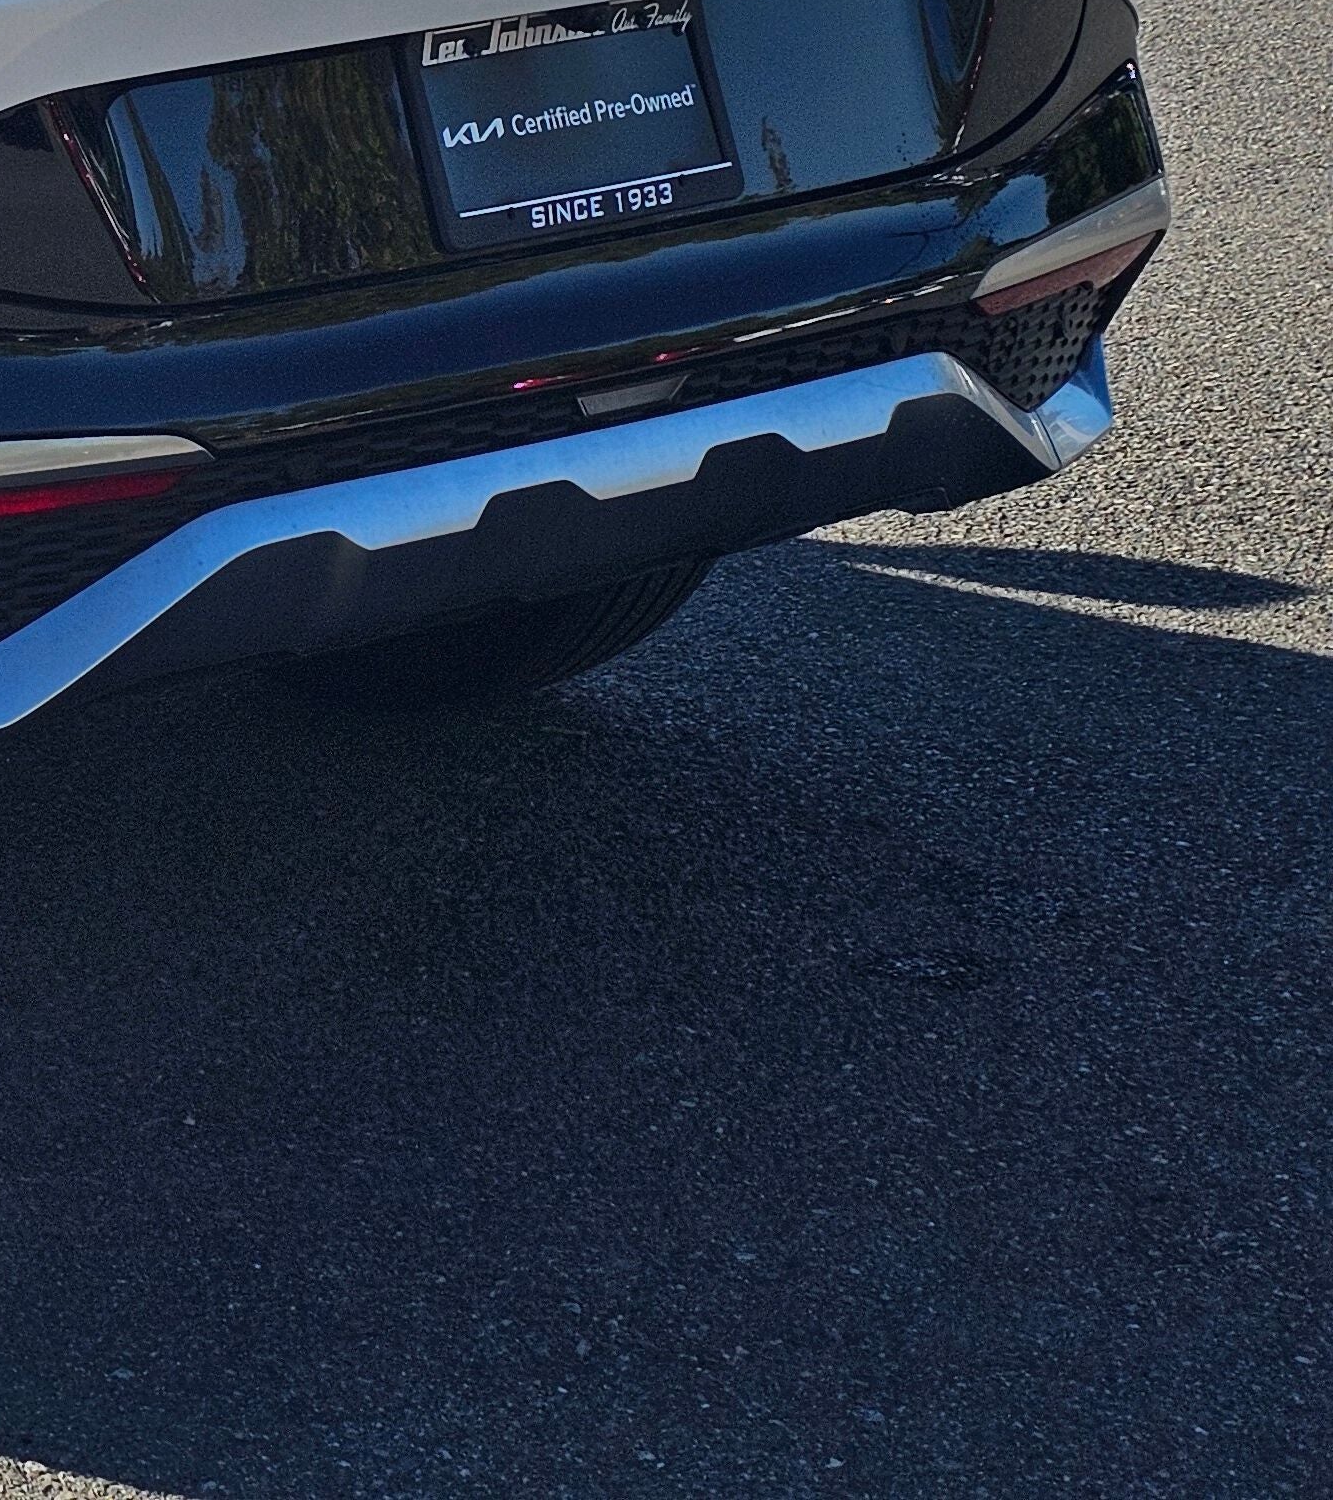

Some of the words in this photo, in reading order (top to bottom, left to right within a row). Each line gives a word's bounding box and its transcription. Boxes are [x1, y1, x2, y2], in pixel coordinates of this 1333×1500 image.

[442, 117, 505, 148] KIA
[511, 102, 593, 136] Certified
[594, 85, 695, 122] Pre-Owned
[531, 195, 605, 229] SINCE
[615, 183, 673, 213] 1933
